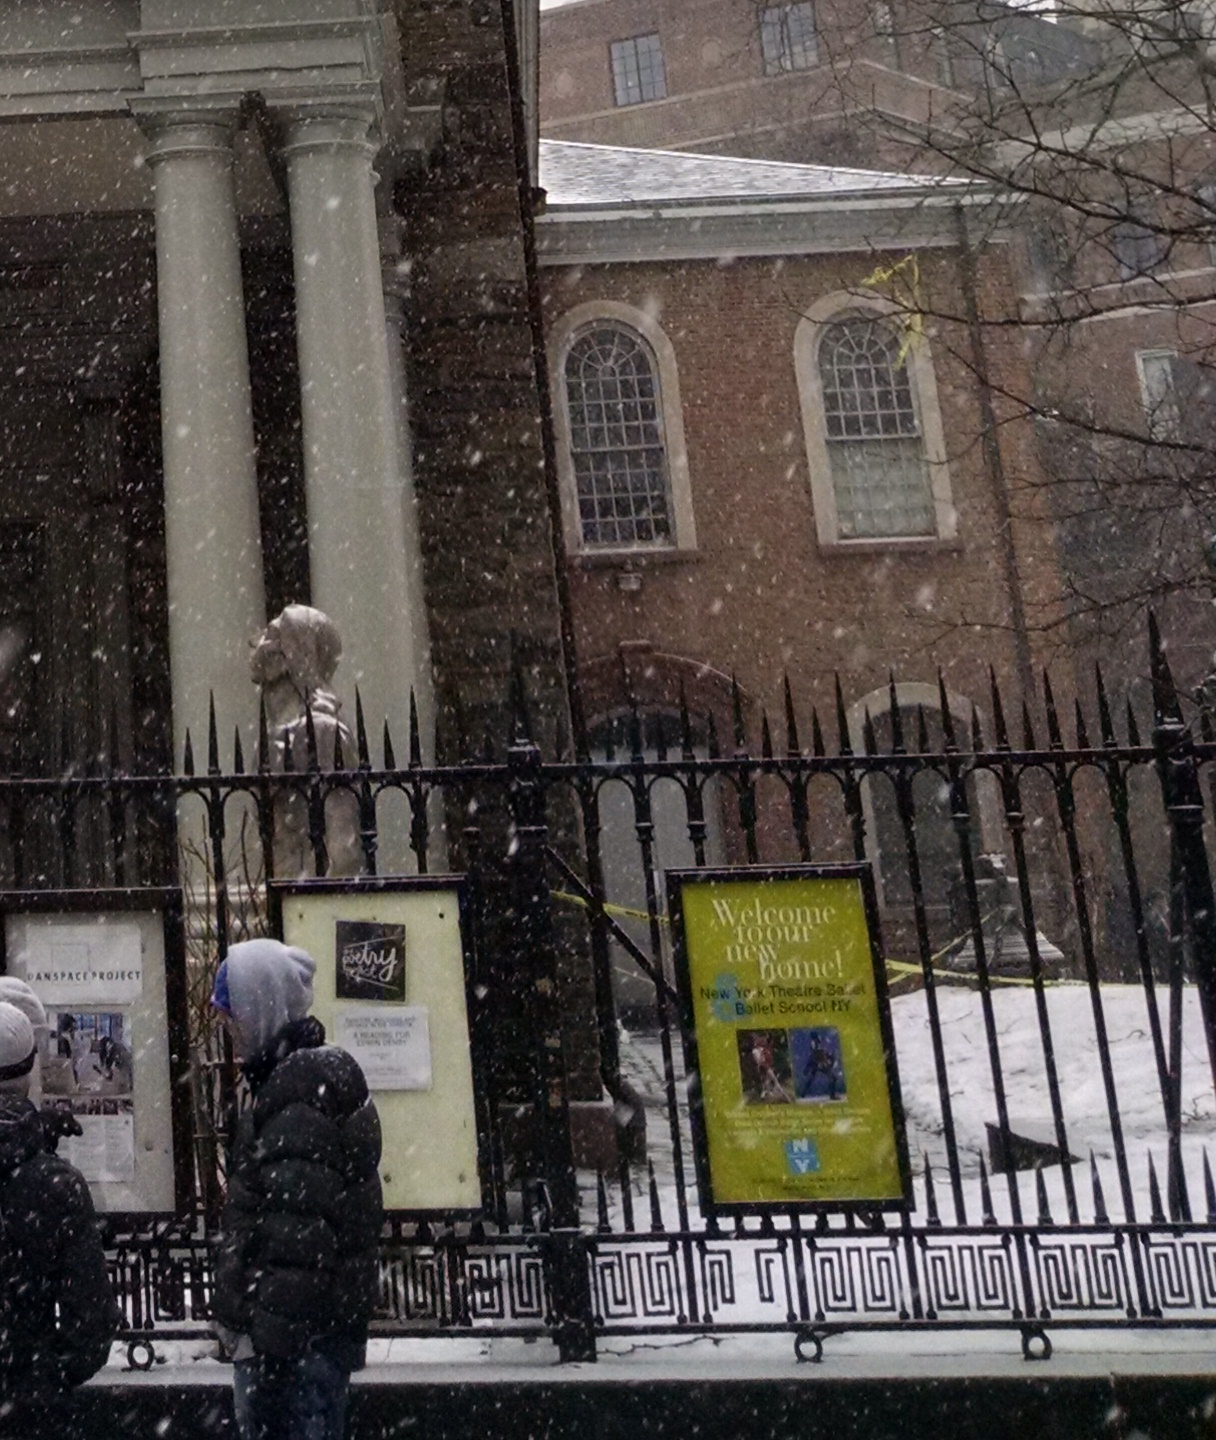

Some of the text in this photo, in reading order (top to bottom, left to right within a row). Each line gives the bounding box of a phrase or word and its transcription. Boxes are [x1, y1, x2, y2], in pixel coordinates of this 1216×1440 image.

[711, 898, 836, 927] Welcome
[734, 924, 813, 944] to our
[726, 943, 780, 963] new
[758, 949, 844, 983] home!
[91, 970, 141, 981] PROJECT
[700, 986, 730, 1000] New
[734, 986, 764, 999] York
[769, 984, 822, 999] Theatre
[735, 999, 852, 1015] Ballet School NY
[792, 1137, 809, 1153] N
[794, 1158, 810, 1174] Y
